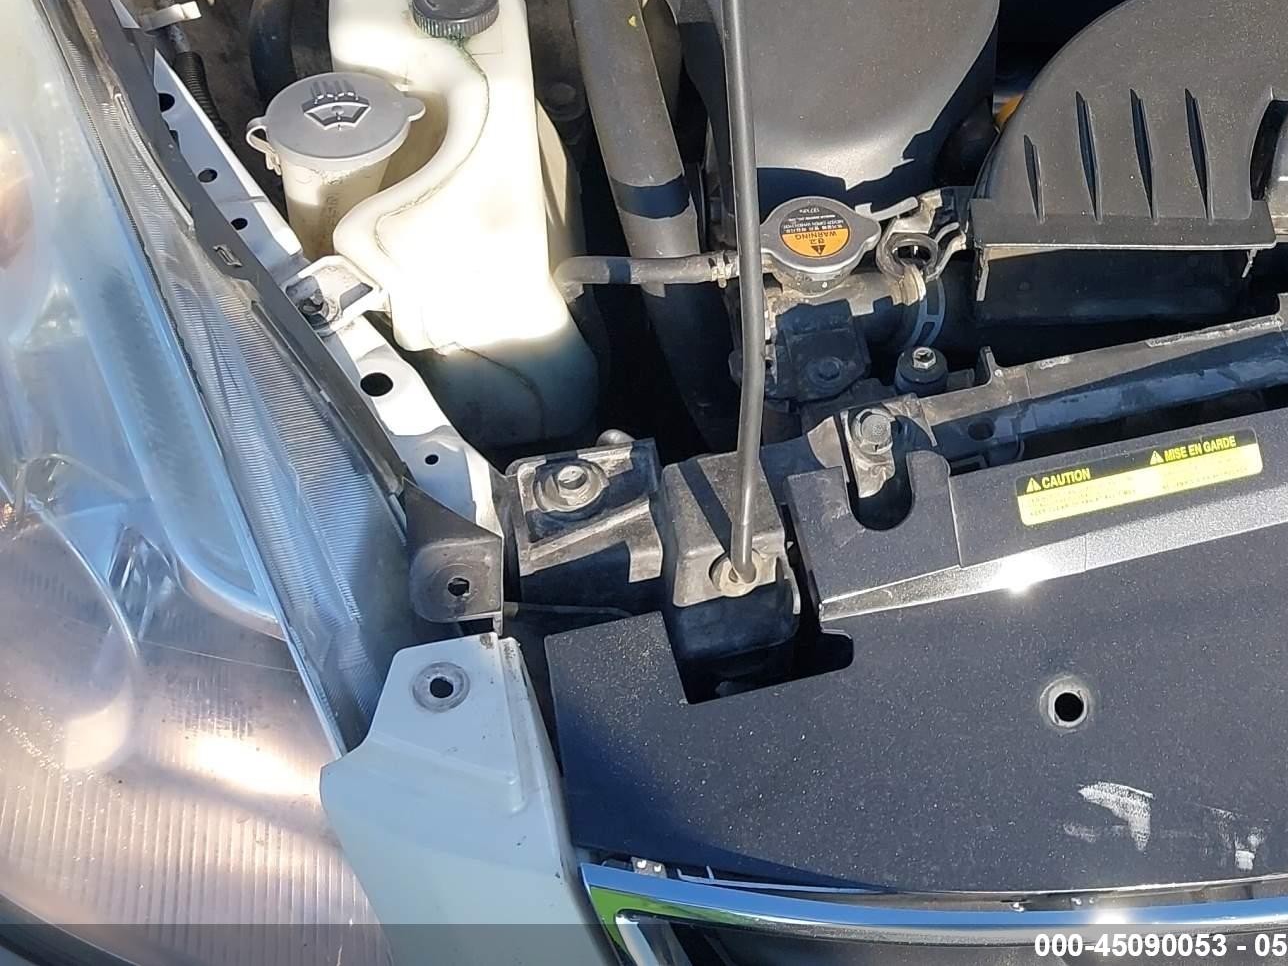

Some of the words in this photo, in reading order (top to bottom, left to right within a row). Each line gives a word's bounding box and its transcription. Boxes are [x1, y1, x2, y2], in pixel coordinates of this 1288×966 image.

[794, 231, 838, 240] WARNING
[1164, 446, 1188, 462] MISE
[1188, 443, 1203, 456] EN
[1203, 435, 1237, 452] GARDE
[1041, 467, 1092, 489] CAUTION
